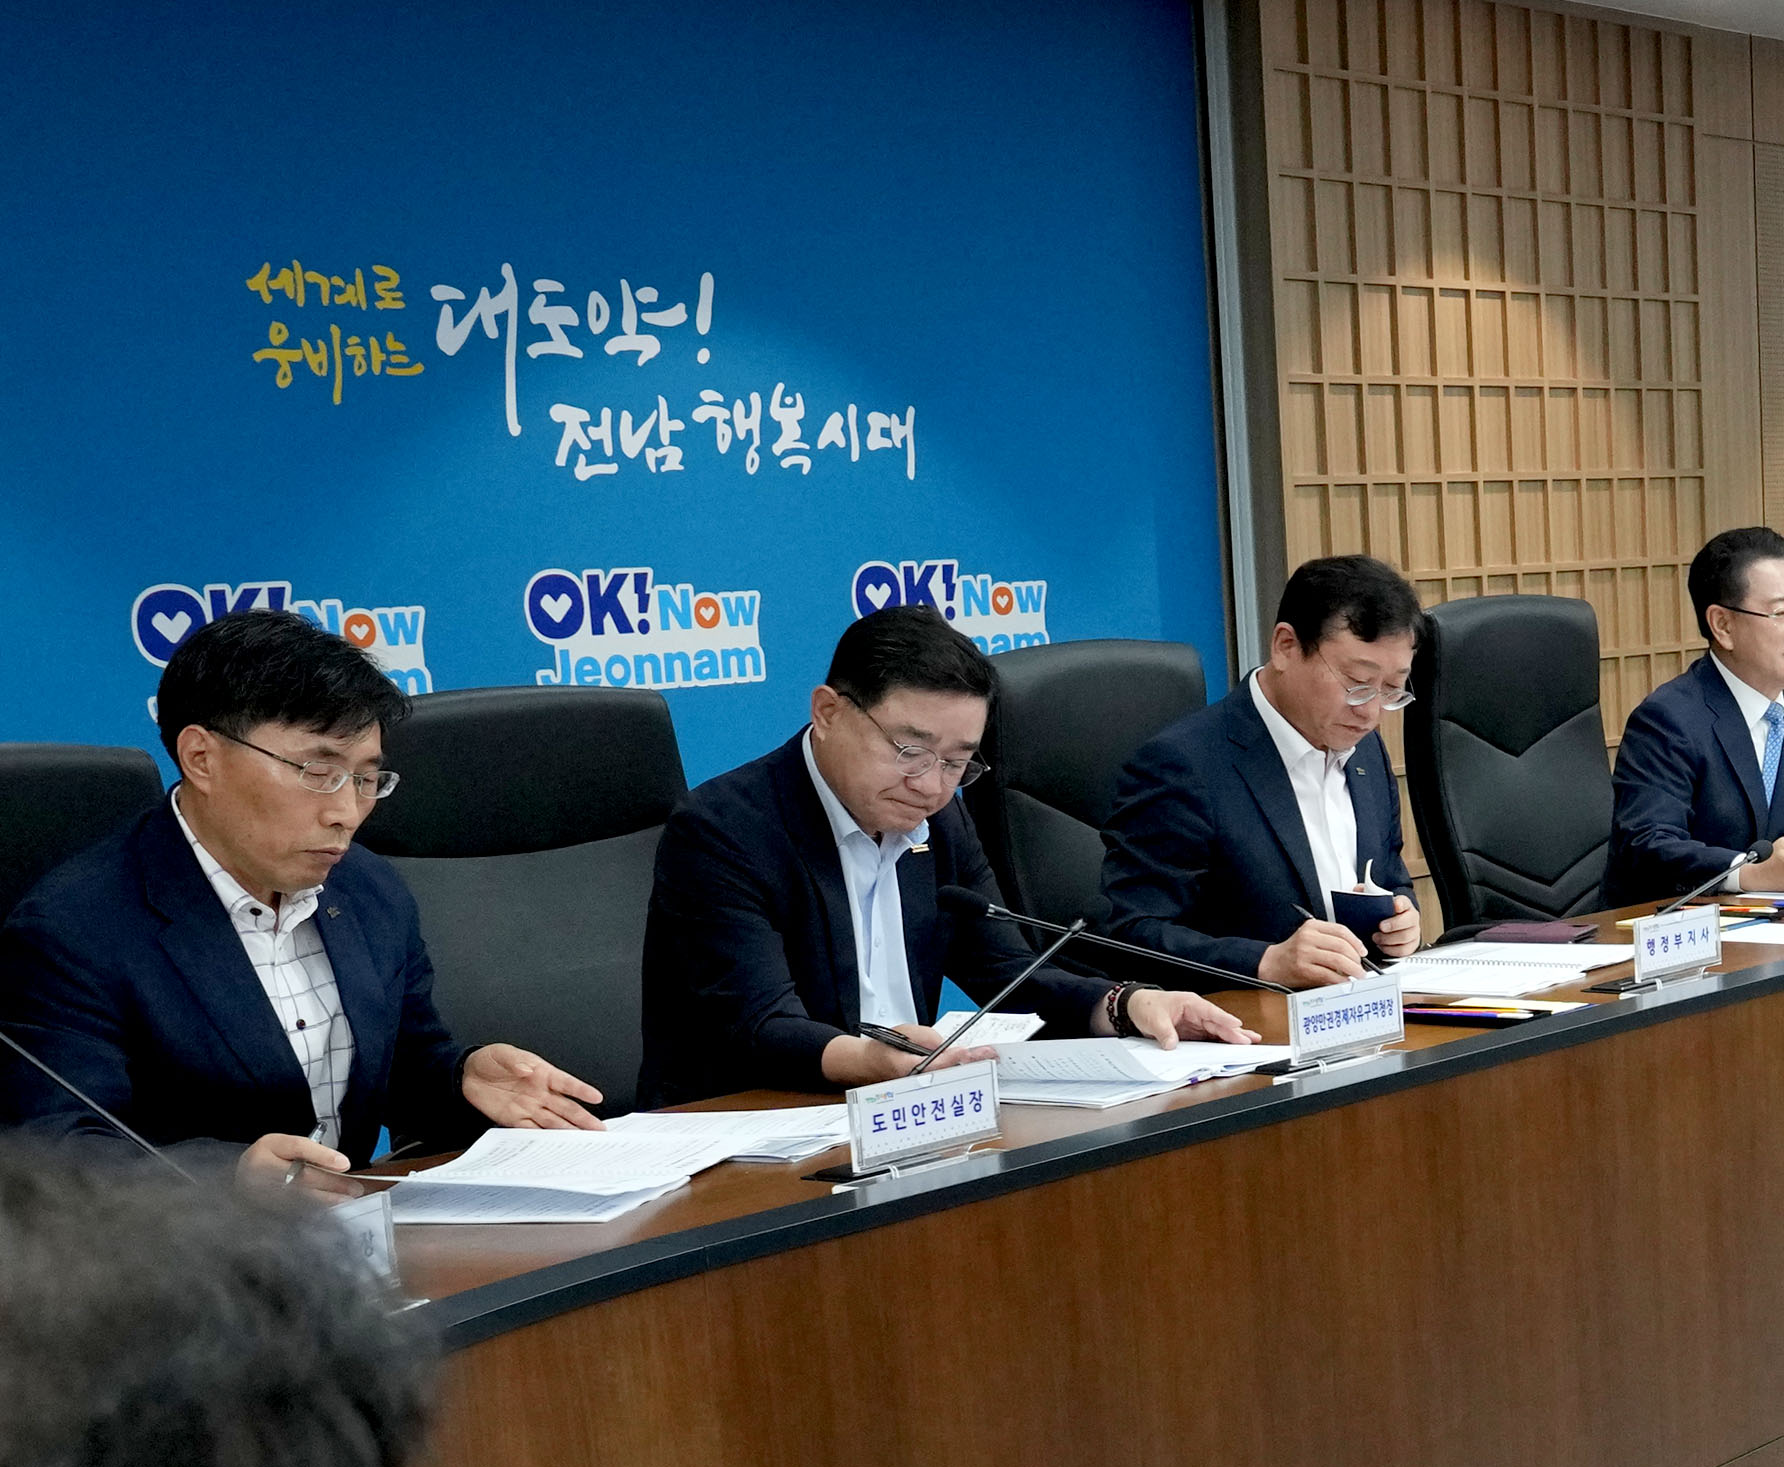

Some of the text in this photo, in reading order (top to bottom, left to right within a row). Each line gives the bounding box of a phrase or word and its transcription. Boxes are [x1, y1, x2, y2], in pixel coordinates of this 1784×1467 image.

[246, 259, 406, 311] 세계로
[253, 320, 425, 405] 웅비하는
[430, 262, 714, 437] 대도약!
[528, 572, 757, 640] OK! Now
[962, 578, 1045, 617] Now
[540, 646, 762, 688] Jeonnam
[1646, 926, 1709, 956] 행정부지사
[1303, 998, 1394, 1035] 광양만권경제자유구역청장
[872, 1090, 983, 1133] 도민안전실장
